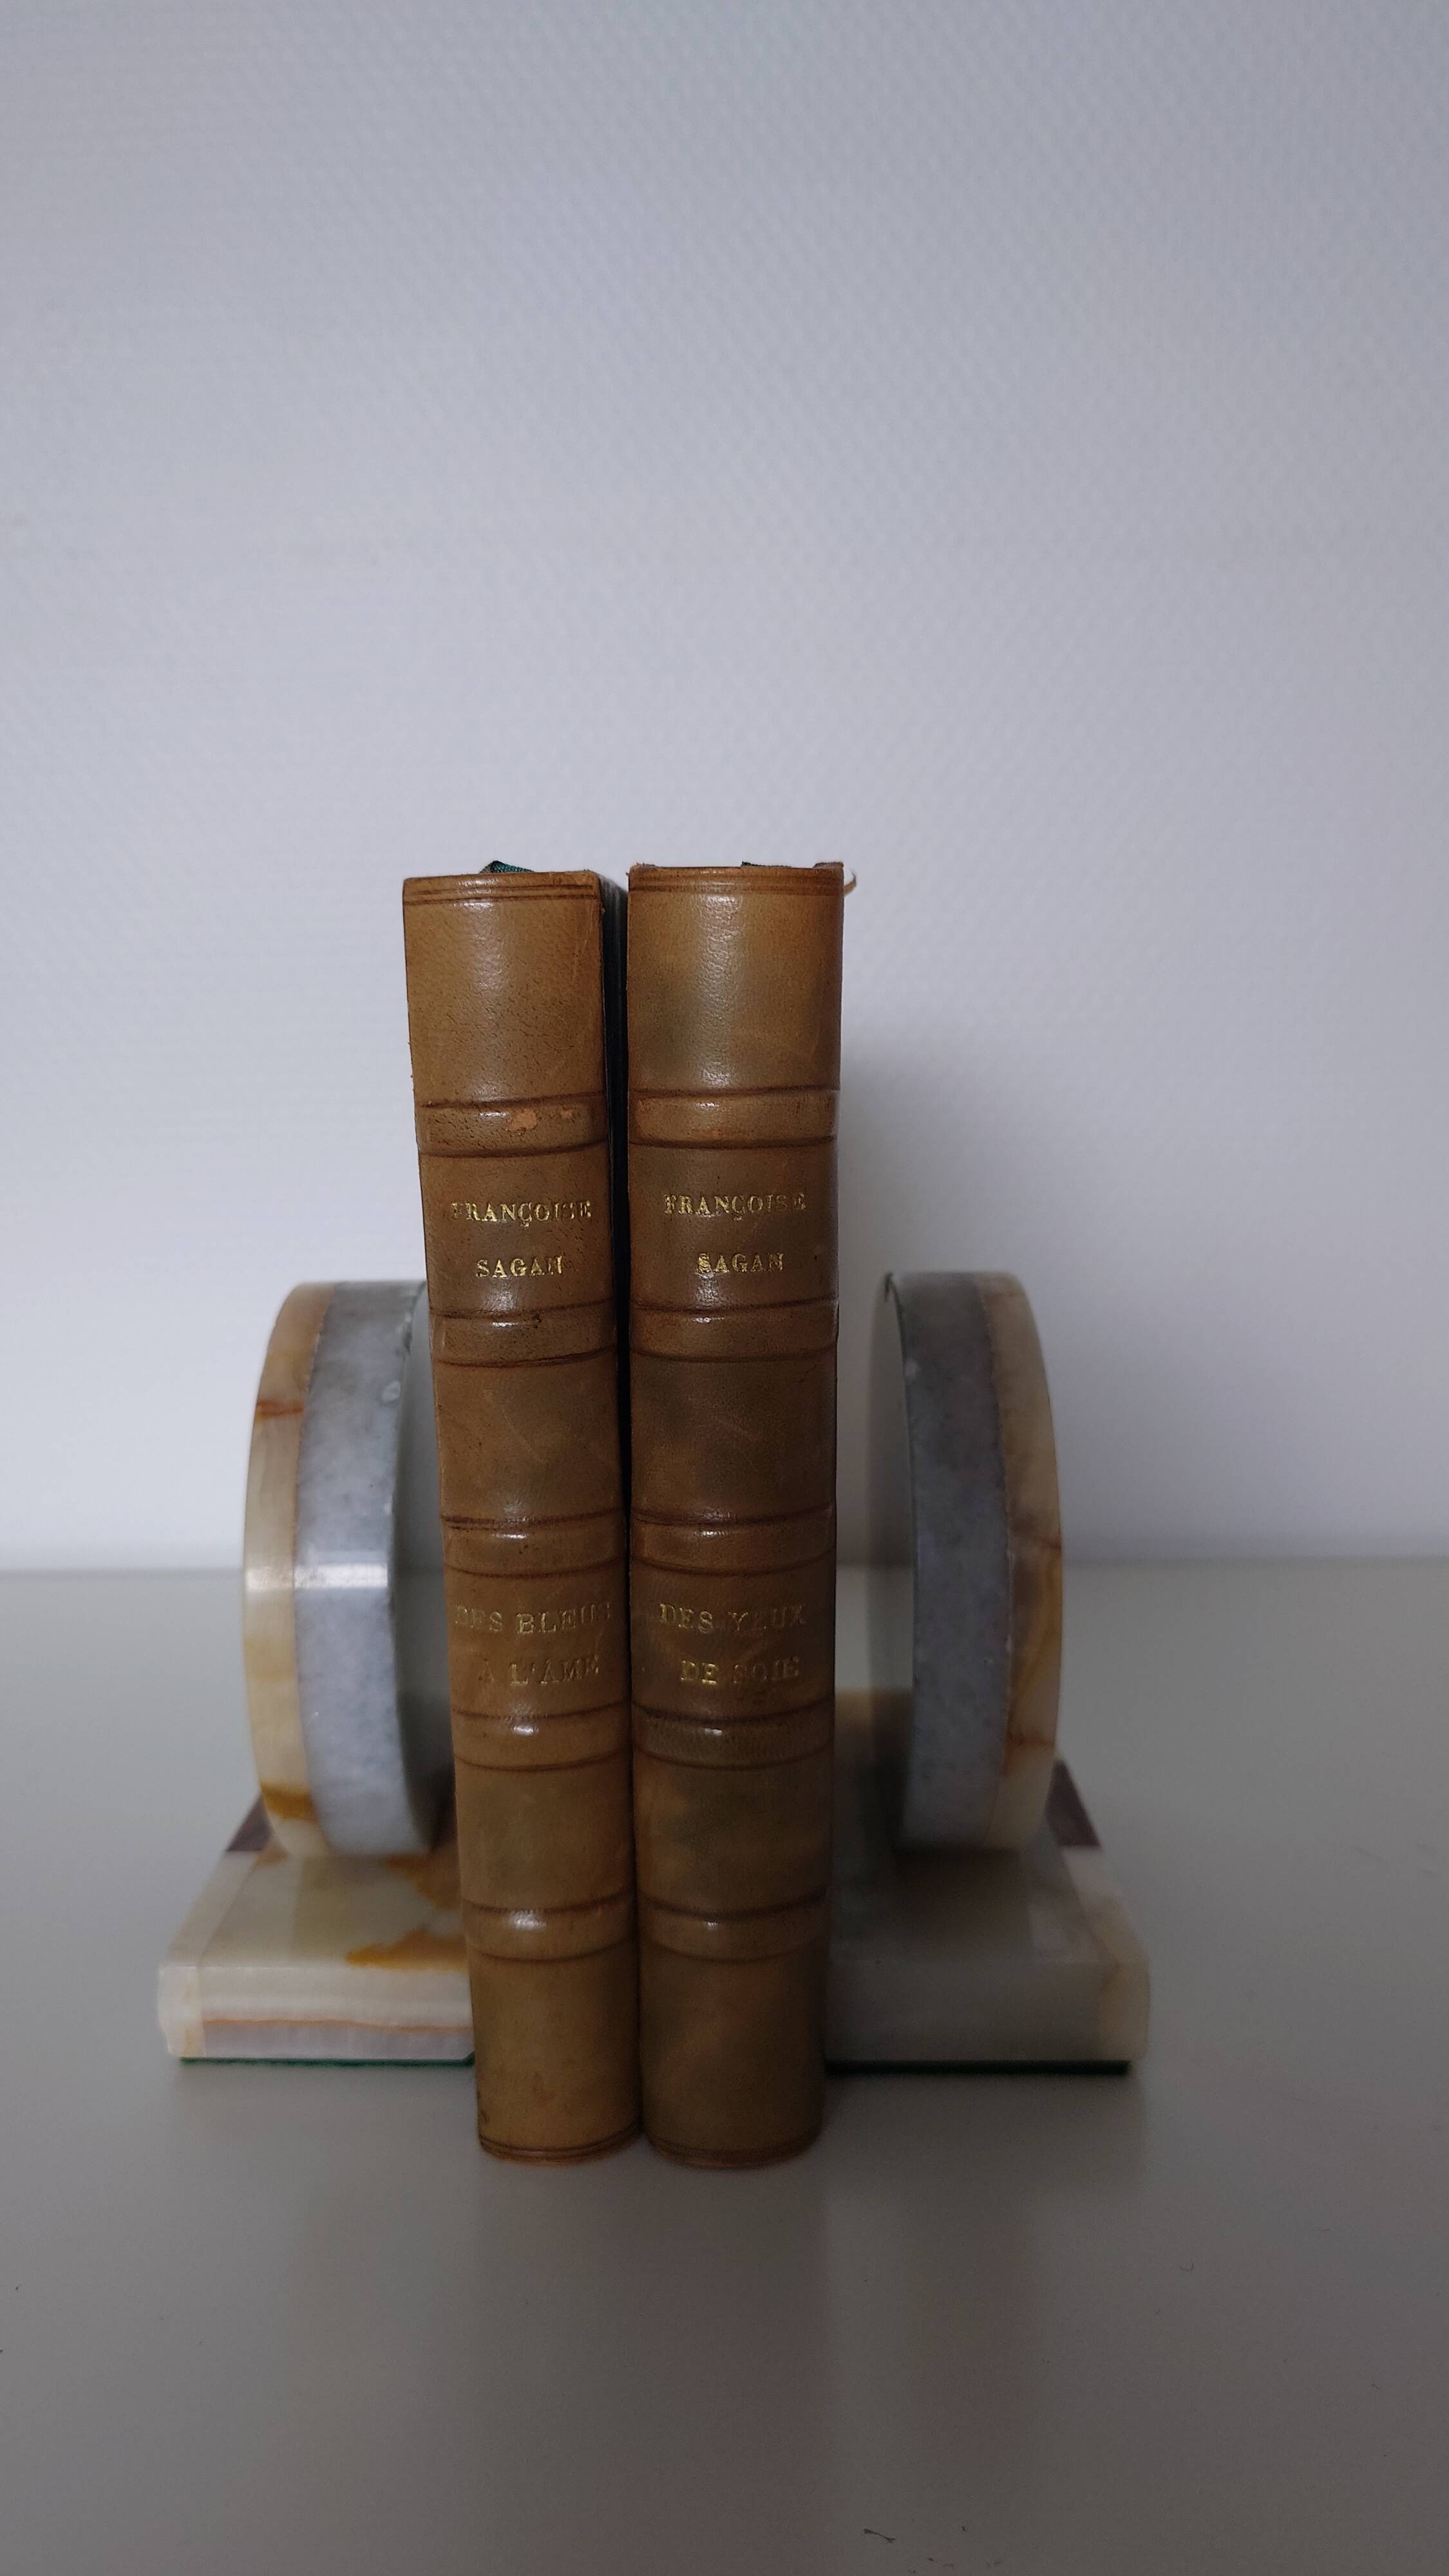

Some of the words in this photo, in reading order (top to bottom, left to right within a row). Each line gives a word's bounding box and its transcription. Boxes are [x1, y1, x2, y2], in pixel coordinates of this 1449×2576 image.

[663, 1193, 807, 1221] FRANÇOISE
[475, 1255, 563, 1278] SAGAN
[696, 1253, 784, 1274] SAGAN
[659, 1603, 714, 1634] DES
[728, 1605, 805, 1632] YUX
[681, 1659, 718, 1685] DE
